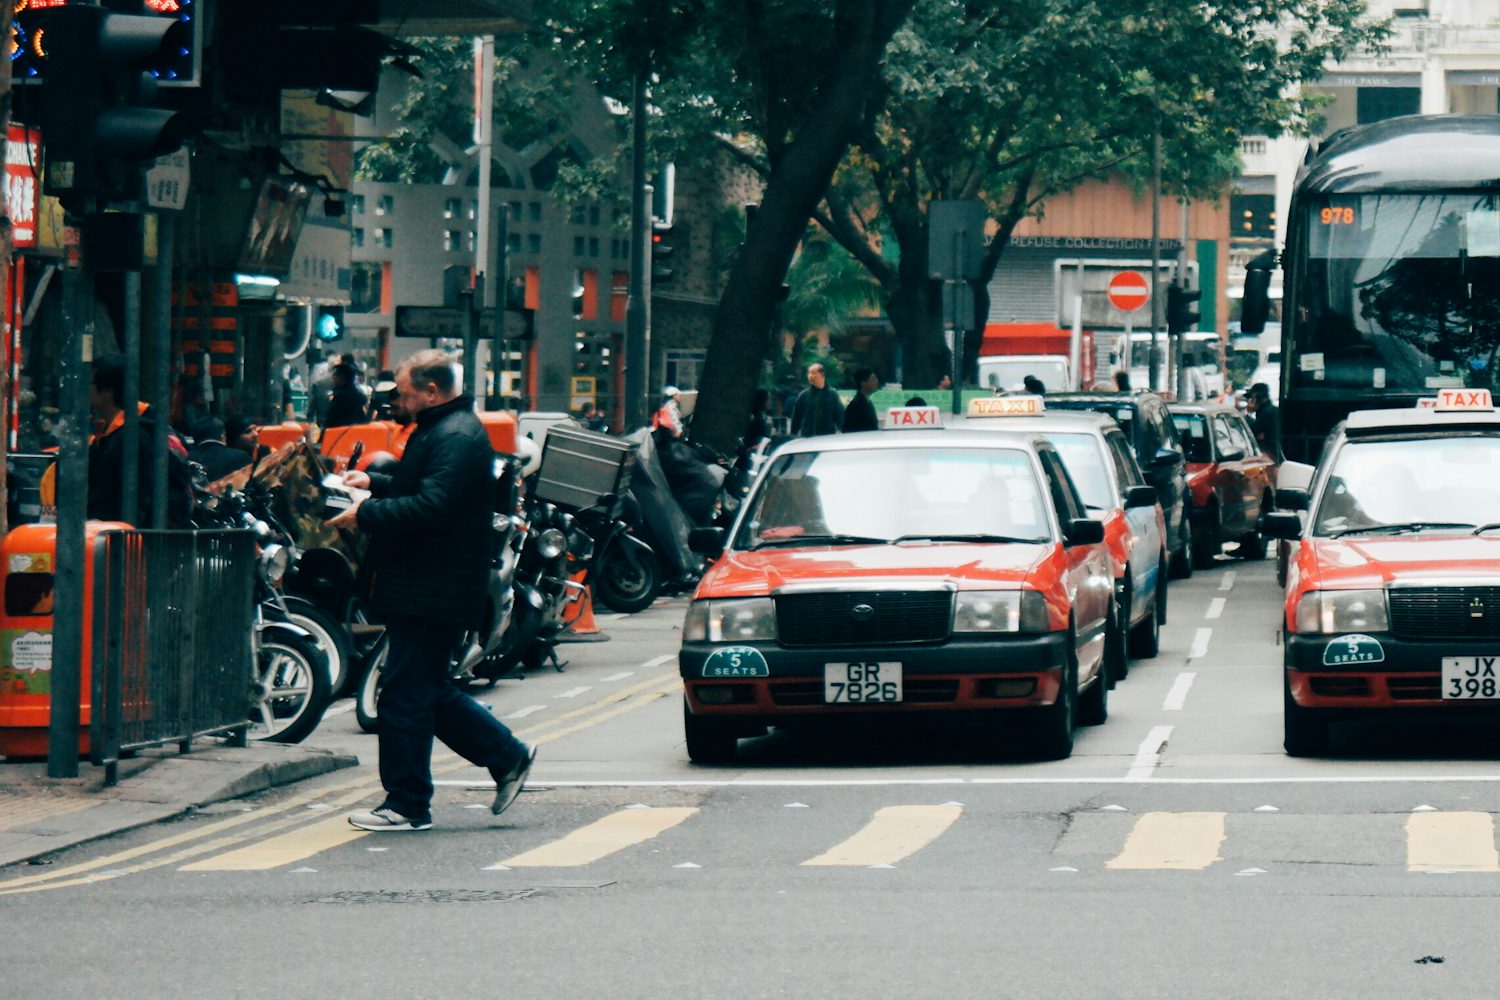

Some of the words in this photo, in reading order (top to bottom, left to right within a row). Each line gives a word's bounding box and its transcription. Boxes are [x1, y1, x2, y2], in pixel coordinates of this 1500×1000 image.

[1320, 207, 1354, 224] 978
[1010, 237, 1060, 248] REFUSE
[1064, 238, 1144, 249] COLLECTION
[1442, 392, 1488, 406] TAXI
[974, 400, 1036, 413] TAXI
[890, 411, 935, 425] TAXI
[1348, 640, 1359, 654] 5
[730, 654, 742, 667] 5
[1334, 653, 1374, 662] SEATS
[715, 667, 757, 676] SEATS
[847, 663, 880, 682] GR
[1465, 658, 1496, 677] JX
[830, 682, 898, 703] 7826
